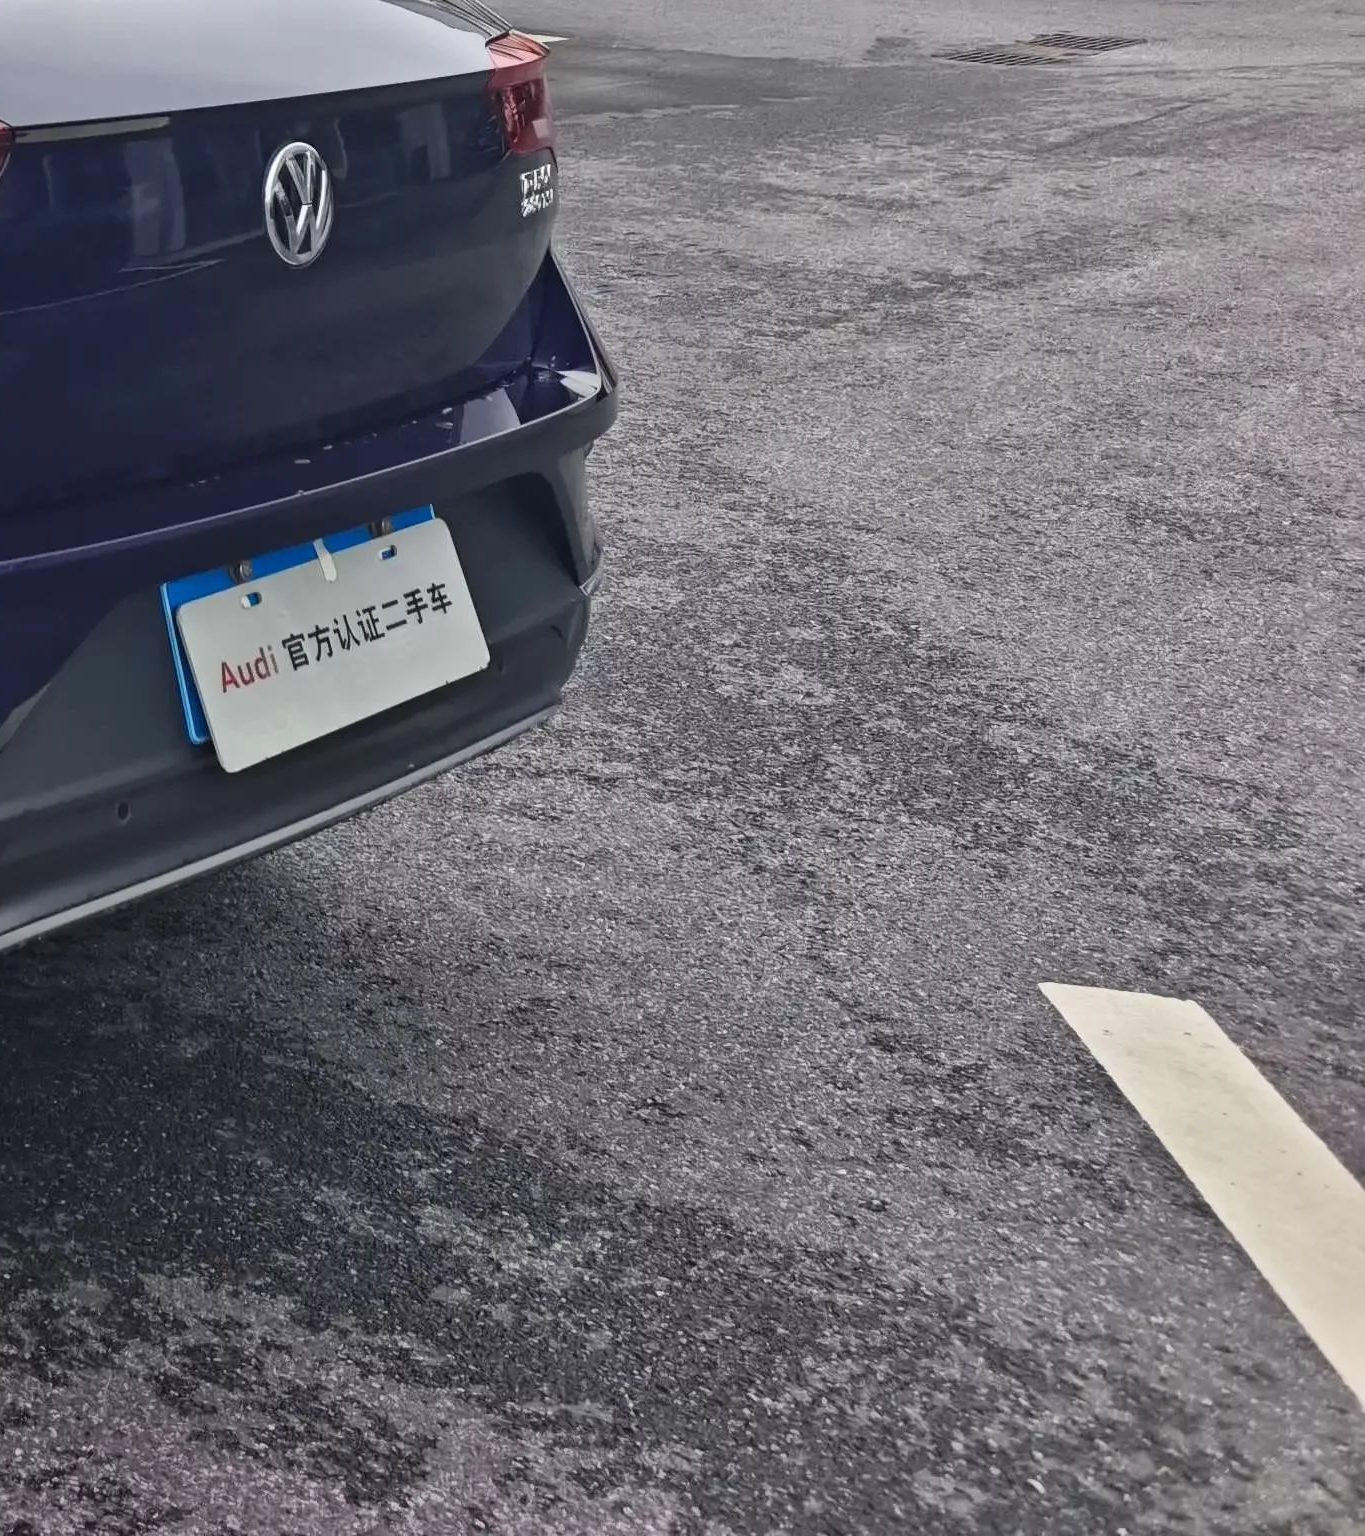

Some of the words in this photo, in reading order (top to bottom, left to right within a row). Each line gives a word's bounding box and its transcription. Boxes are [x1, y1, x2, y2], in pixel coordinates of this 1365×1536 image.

[220, 645, 279, 693] Audi
[281, 582, 453, 671] 官方认证二手车
